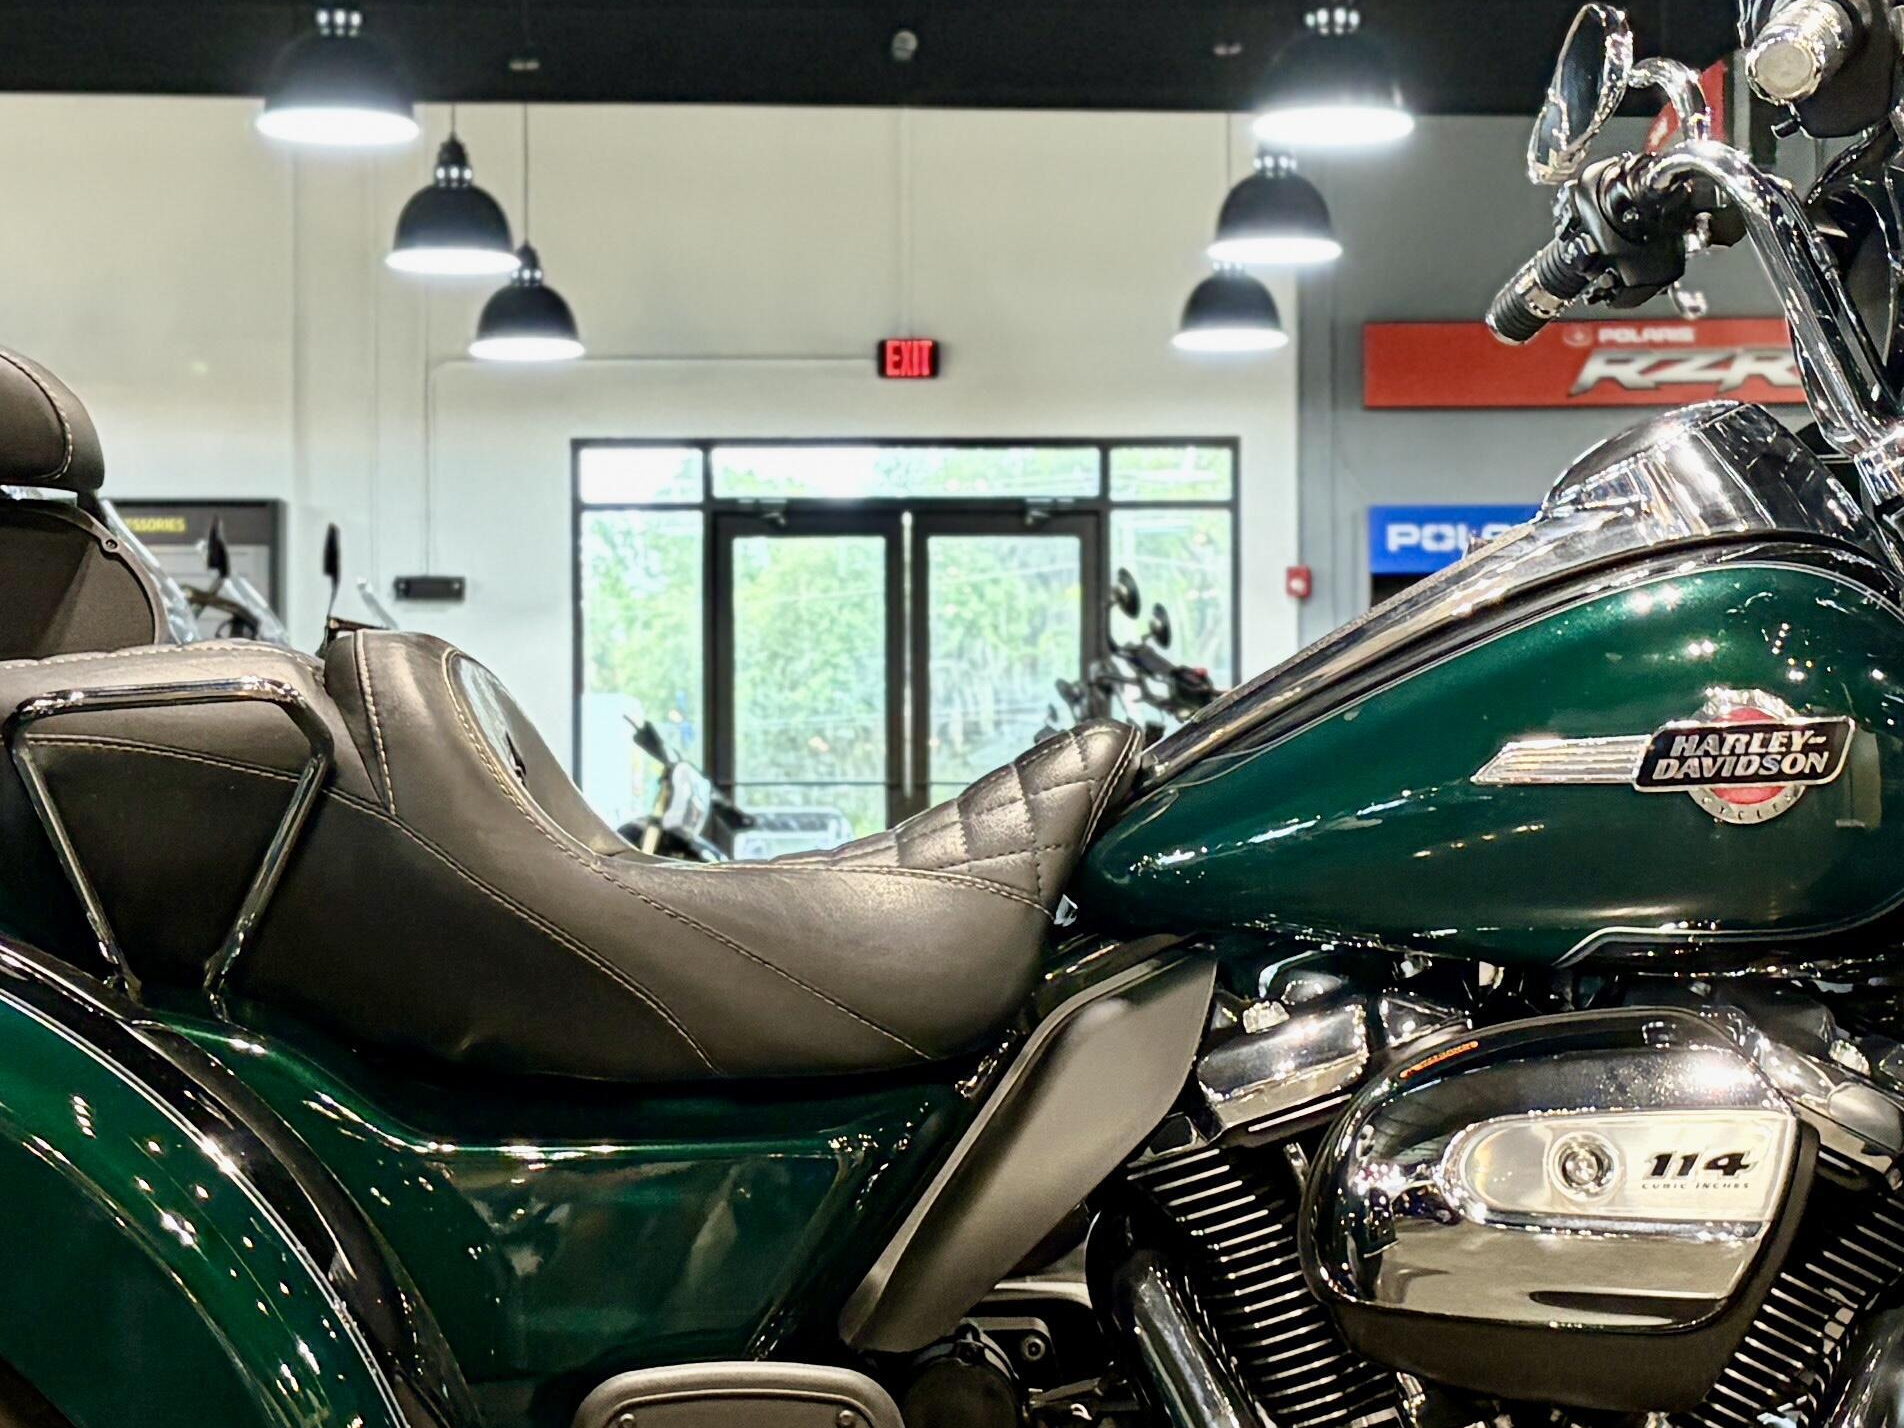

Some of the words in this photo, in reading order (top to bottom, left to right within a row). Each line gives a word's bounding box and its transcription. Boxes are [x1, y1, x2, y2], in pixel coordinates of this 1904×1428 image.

[1599, 328, 1694, 342] POLARIS
[886, 340, 932, 376] EXIT
[1670, 730, 1826, 757] HARLEY-
[1652, 751, 1829, 780] DAVIDSON
[1644, 1152, 1758, 1180] 114
